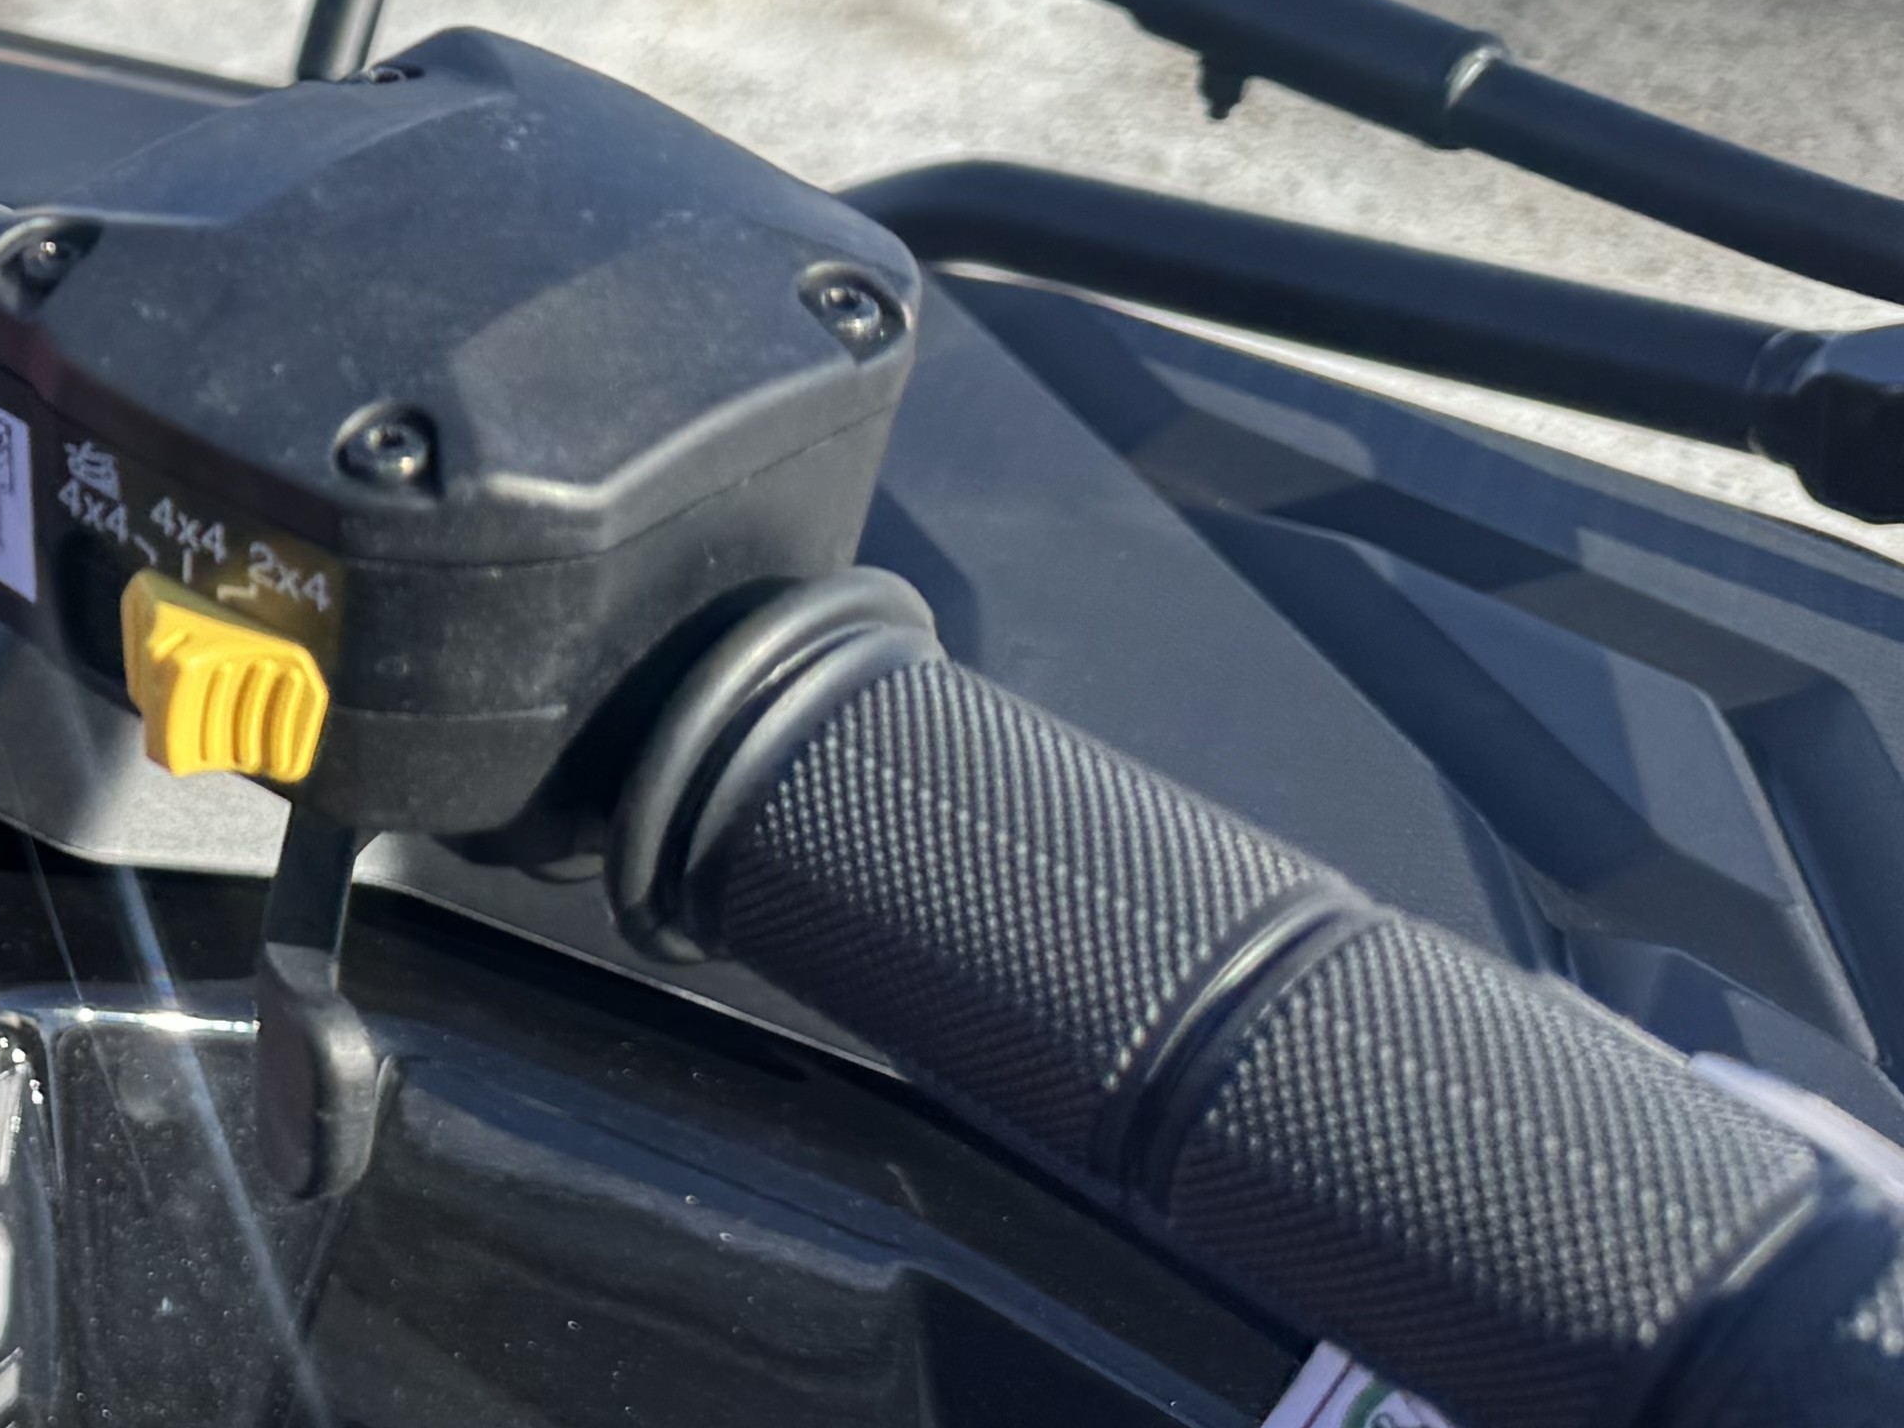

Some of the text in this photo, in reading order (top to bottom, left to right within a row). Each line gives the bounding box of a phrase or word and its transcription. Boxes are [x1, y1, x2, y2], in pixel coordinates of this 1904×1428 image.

[57, 478, 129, 544] 4x4
[149, 496, 228, 564] 4x4
[247, 541, 331, 613] 2x4
